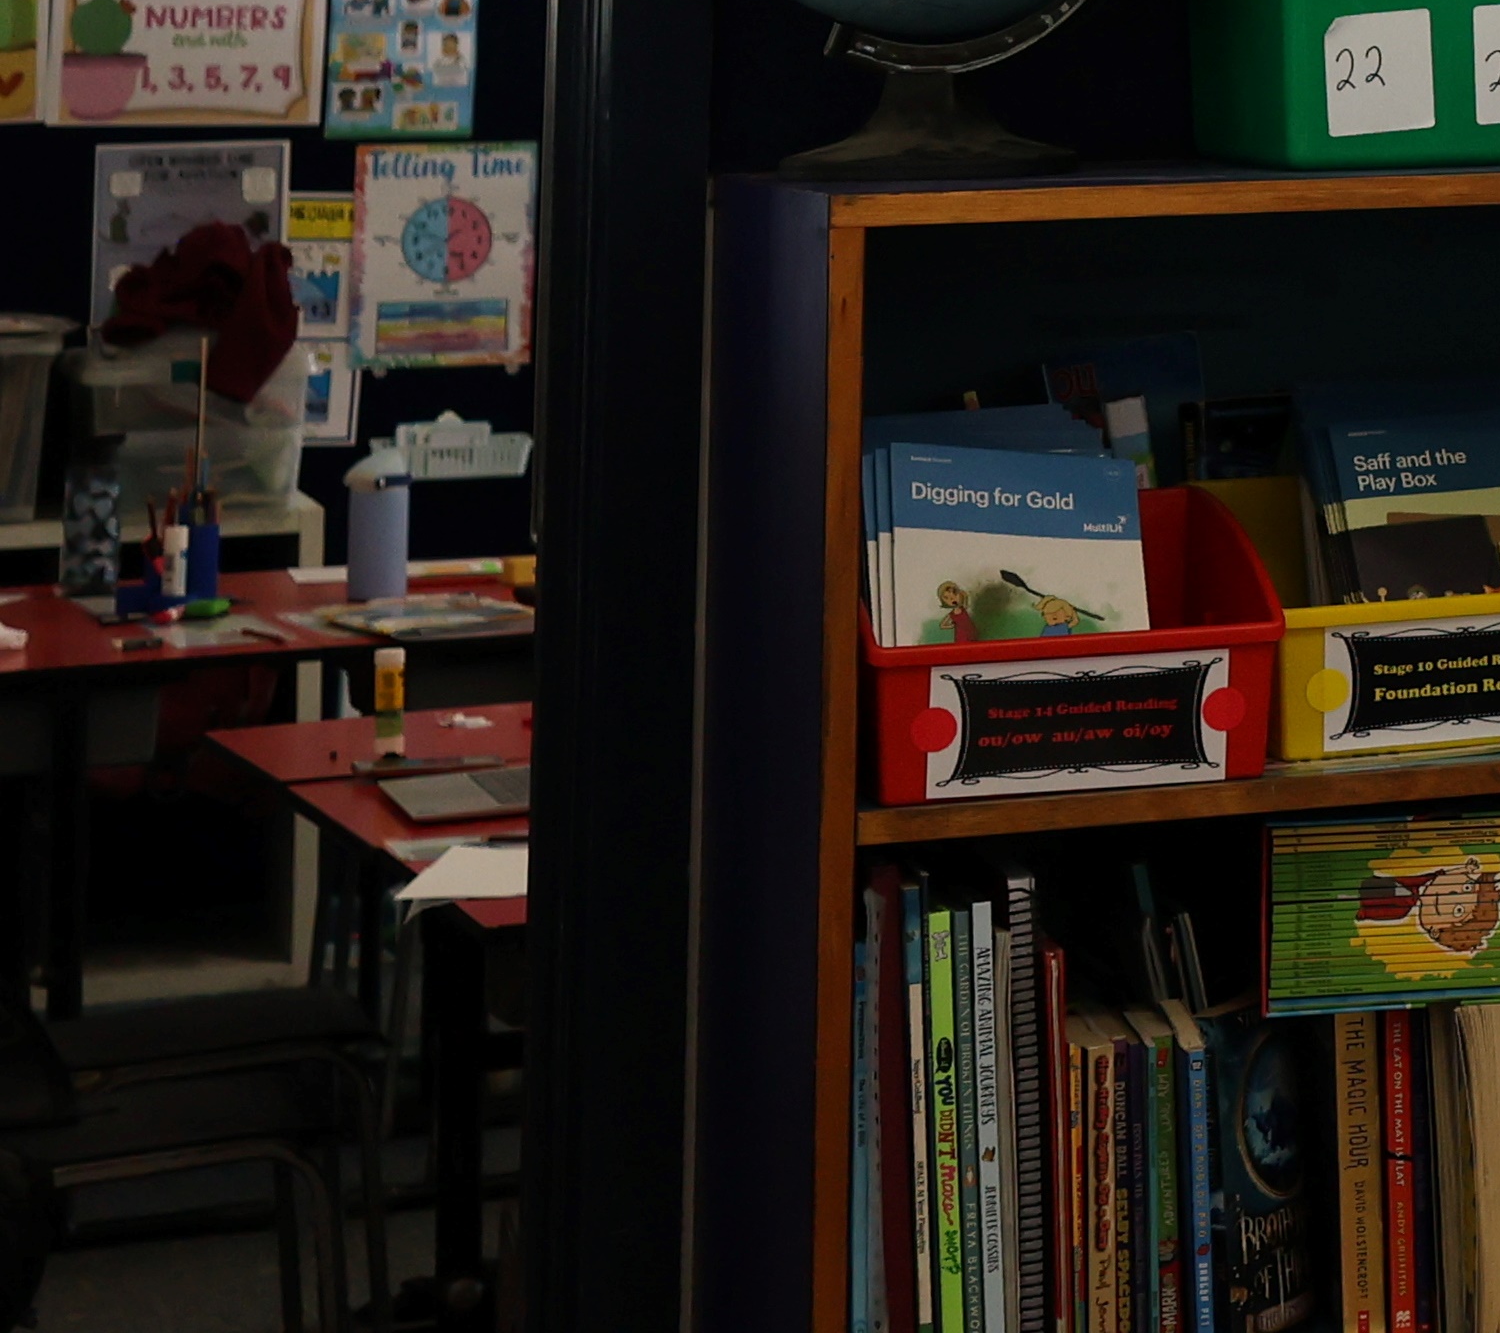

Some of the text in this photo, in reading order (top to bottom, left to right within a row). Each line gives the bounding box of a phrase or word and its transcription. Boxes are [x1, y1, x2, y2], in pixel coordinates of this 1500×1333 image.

[145, 5, 287, 31] NUMBERS
[1335, 46, 1386, 91] 22
[369, 149, 526, 183] Telling Time
[1353, 448, 1467, 472] Saff and the
[911, 482, 1074, 510] Digging for Gold
[1357, 472, 1437, 493] Play Box
[1373, 663, 1413, 677] Stage
[1417, 662, 1434, 672] 10
[1437, 655, 1488, 670] Guided
[1373, 681, 1478, 702] Foundation
[987, 696, 1178, 721] Stage Guided Reading
[978, 732, 1043, 747] ou/ow
[976, 946, 996, 1125] AMAZING ANIMAL JOURNEYS
[958, 963, 979, 1249] GARDEN BROKEN THINGS FREYA
[1342, 1017, 1372, 1170] THE MAGIC HOUR
[936, 1076, 956, 1159] YOU DIDN'T
[1116, 1082, 1127, 1141] DUNCAN
